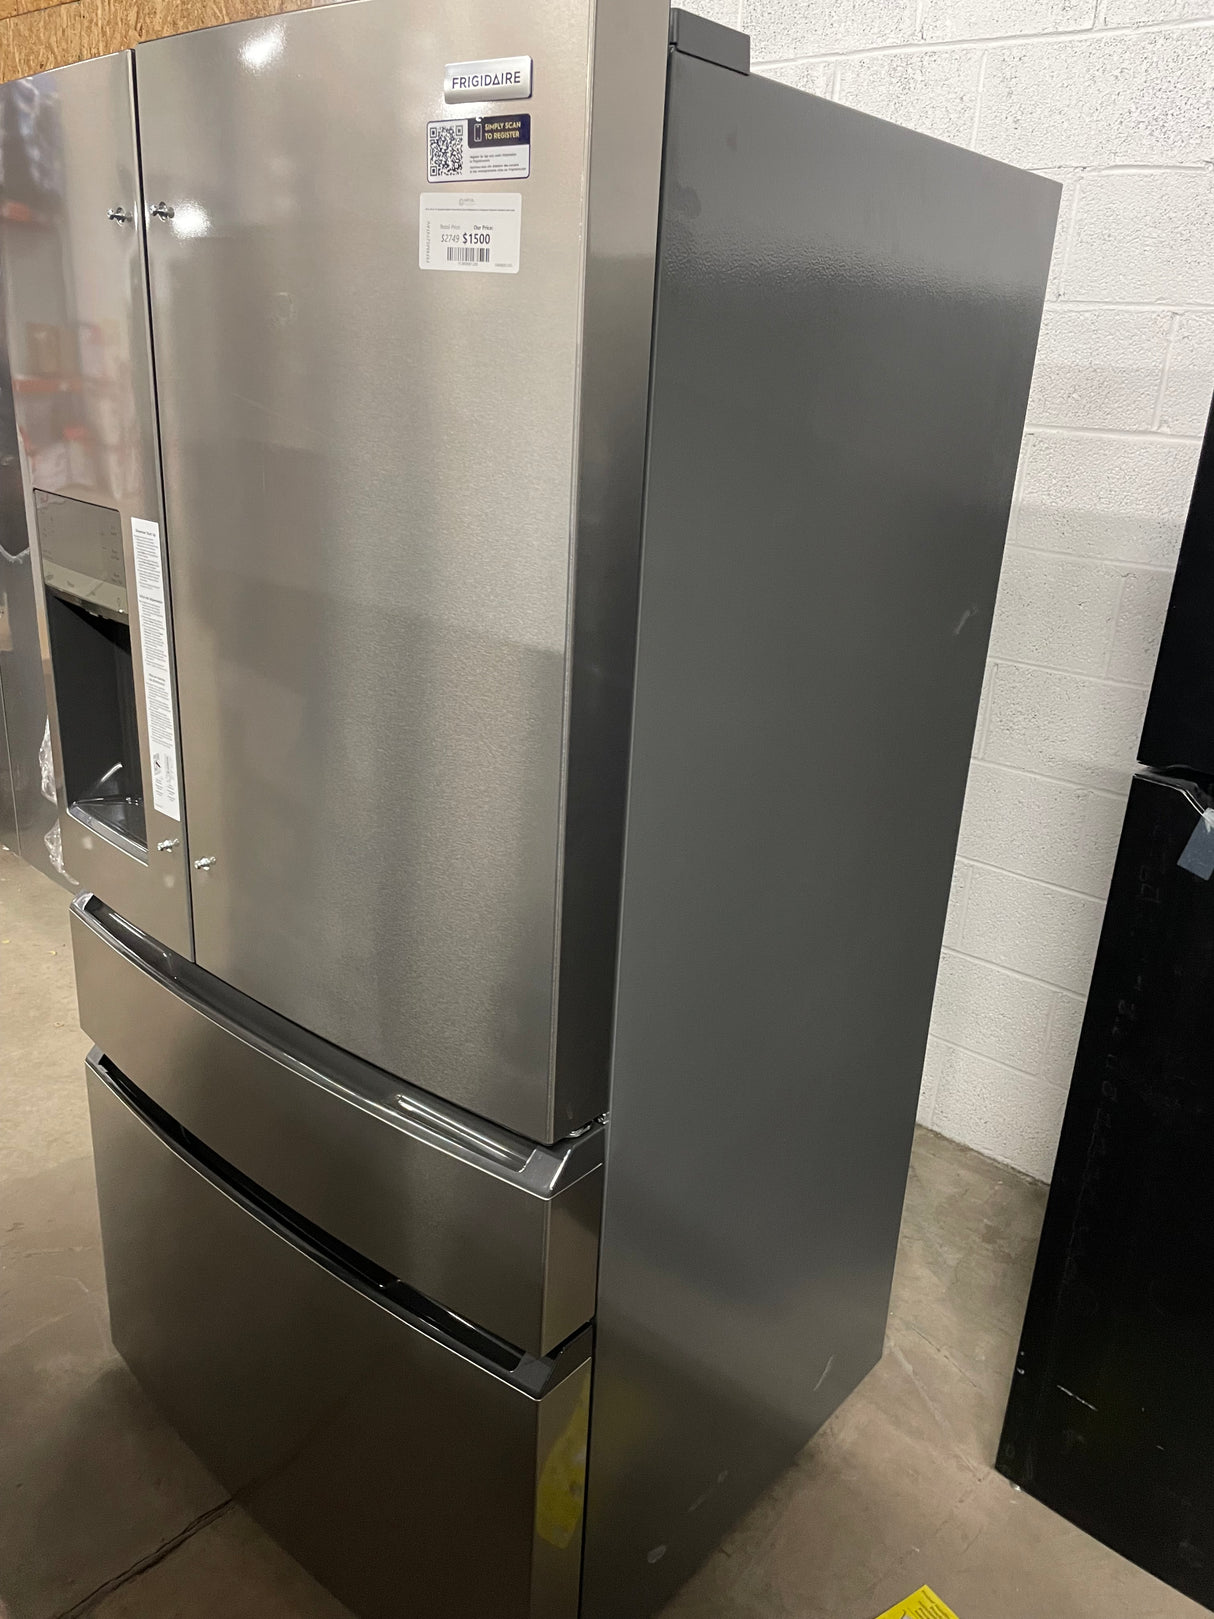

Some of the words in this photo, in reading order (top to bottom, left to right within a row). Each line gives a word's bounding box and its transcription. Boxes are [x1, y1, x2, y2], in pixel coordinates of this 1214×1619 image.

[452, 71, 521, 89] FRIGIDAIRE
[484, 122, 504, 131] SIMPLY
[505, 121, 521, 129] SCAN
[493, 131, 520, 140] REGISTER
[441, 233, 460, 243] $2749
[462, 232, 491, 245] $1500
